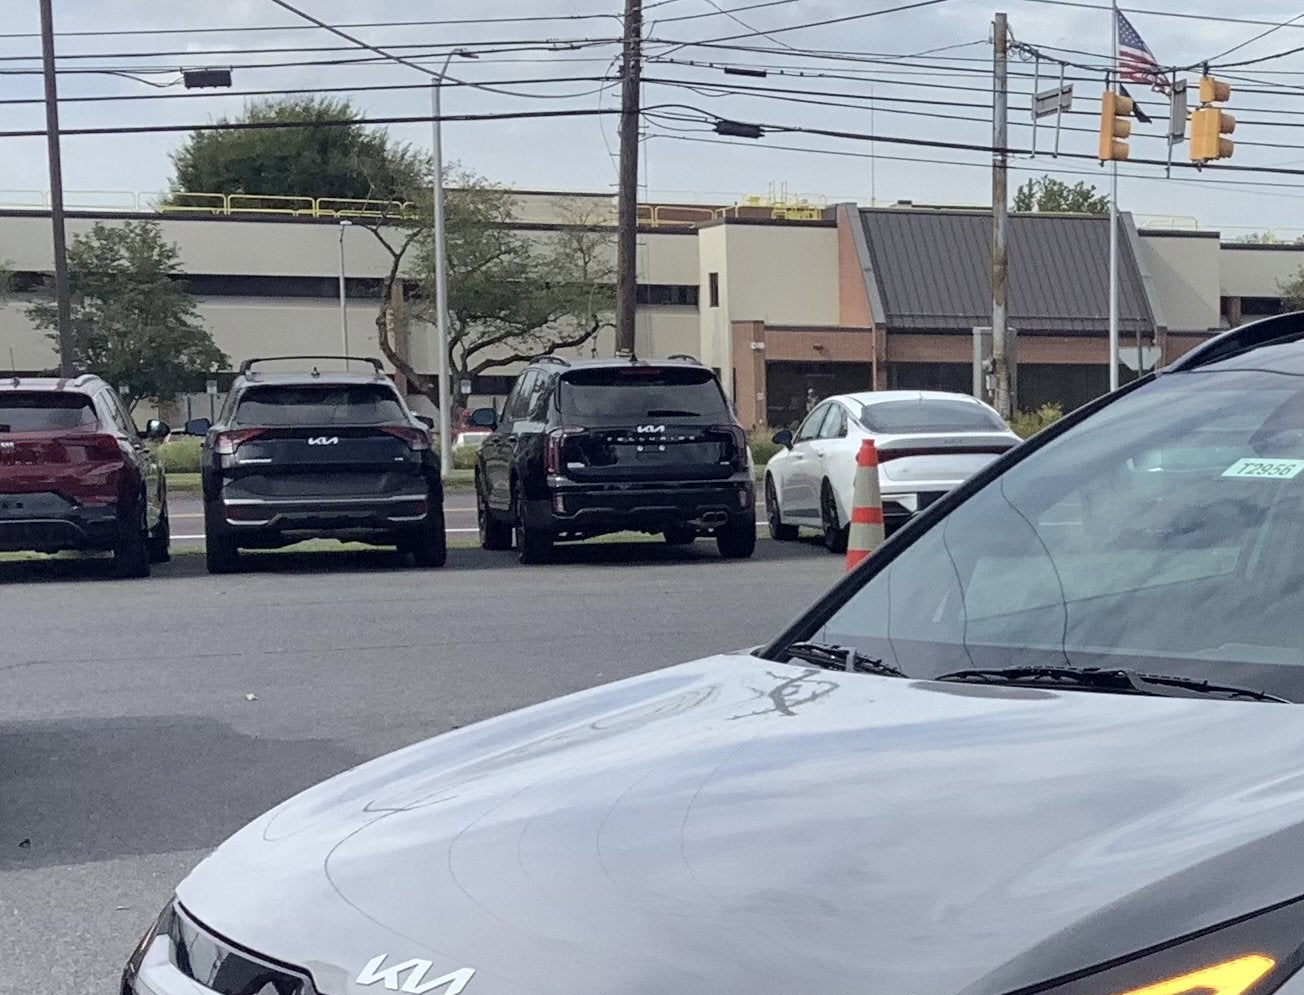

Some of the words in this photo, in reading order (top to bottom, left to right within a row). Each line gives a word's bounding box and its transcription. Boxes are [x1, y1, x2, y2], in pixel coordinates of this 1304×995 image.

[637, 425, 665, 433] KIA
[308, 436, 339, 445] KIA
[1236, 463, 1297, 476] T2956
